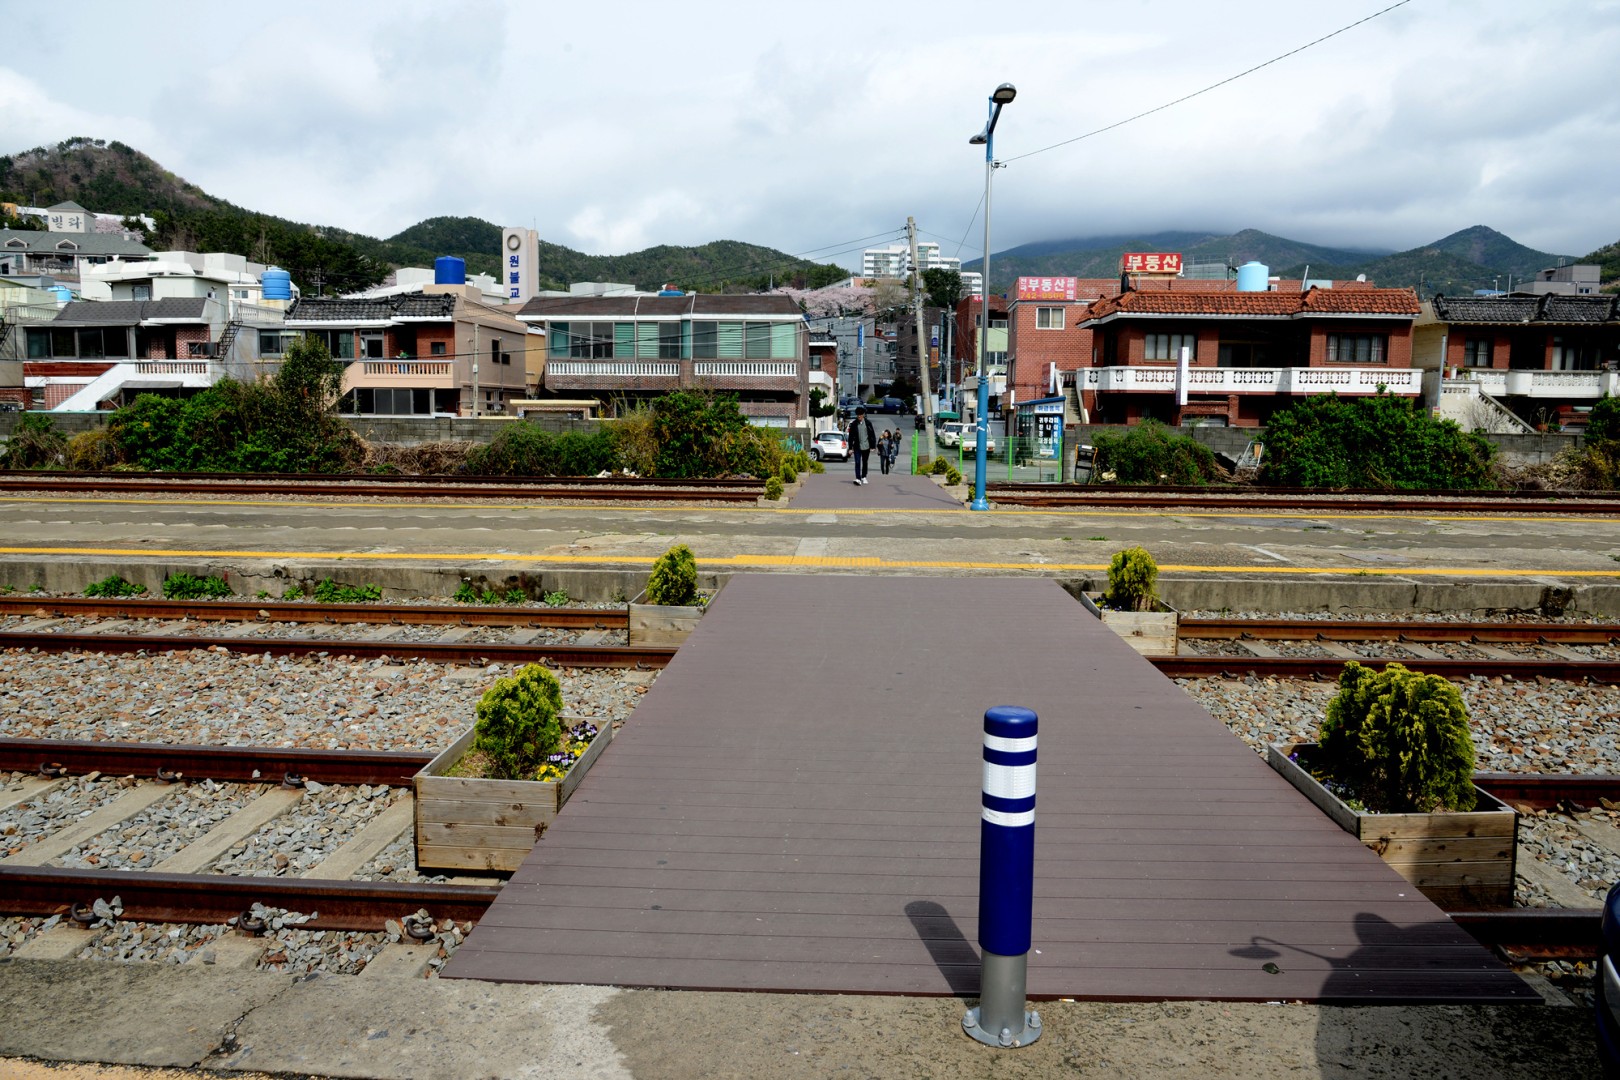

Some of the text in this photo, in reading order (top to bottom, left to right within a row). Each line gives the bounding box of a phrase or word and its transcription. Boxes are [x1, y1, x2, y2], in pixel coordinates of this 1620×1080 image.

[51, 215, 82, 229] 빌라
[1127, 255, 1179, 271] 부동산
[509, 255, 520, 299] 원불교
[1028, 278, 1065, 292] 부동산
